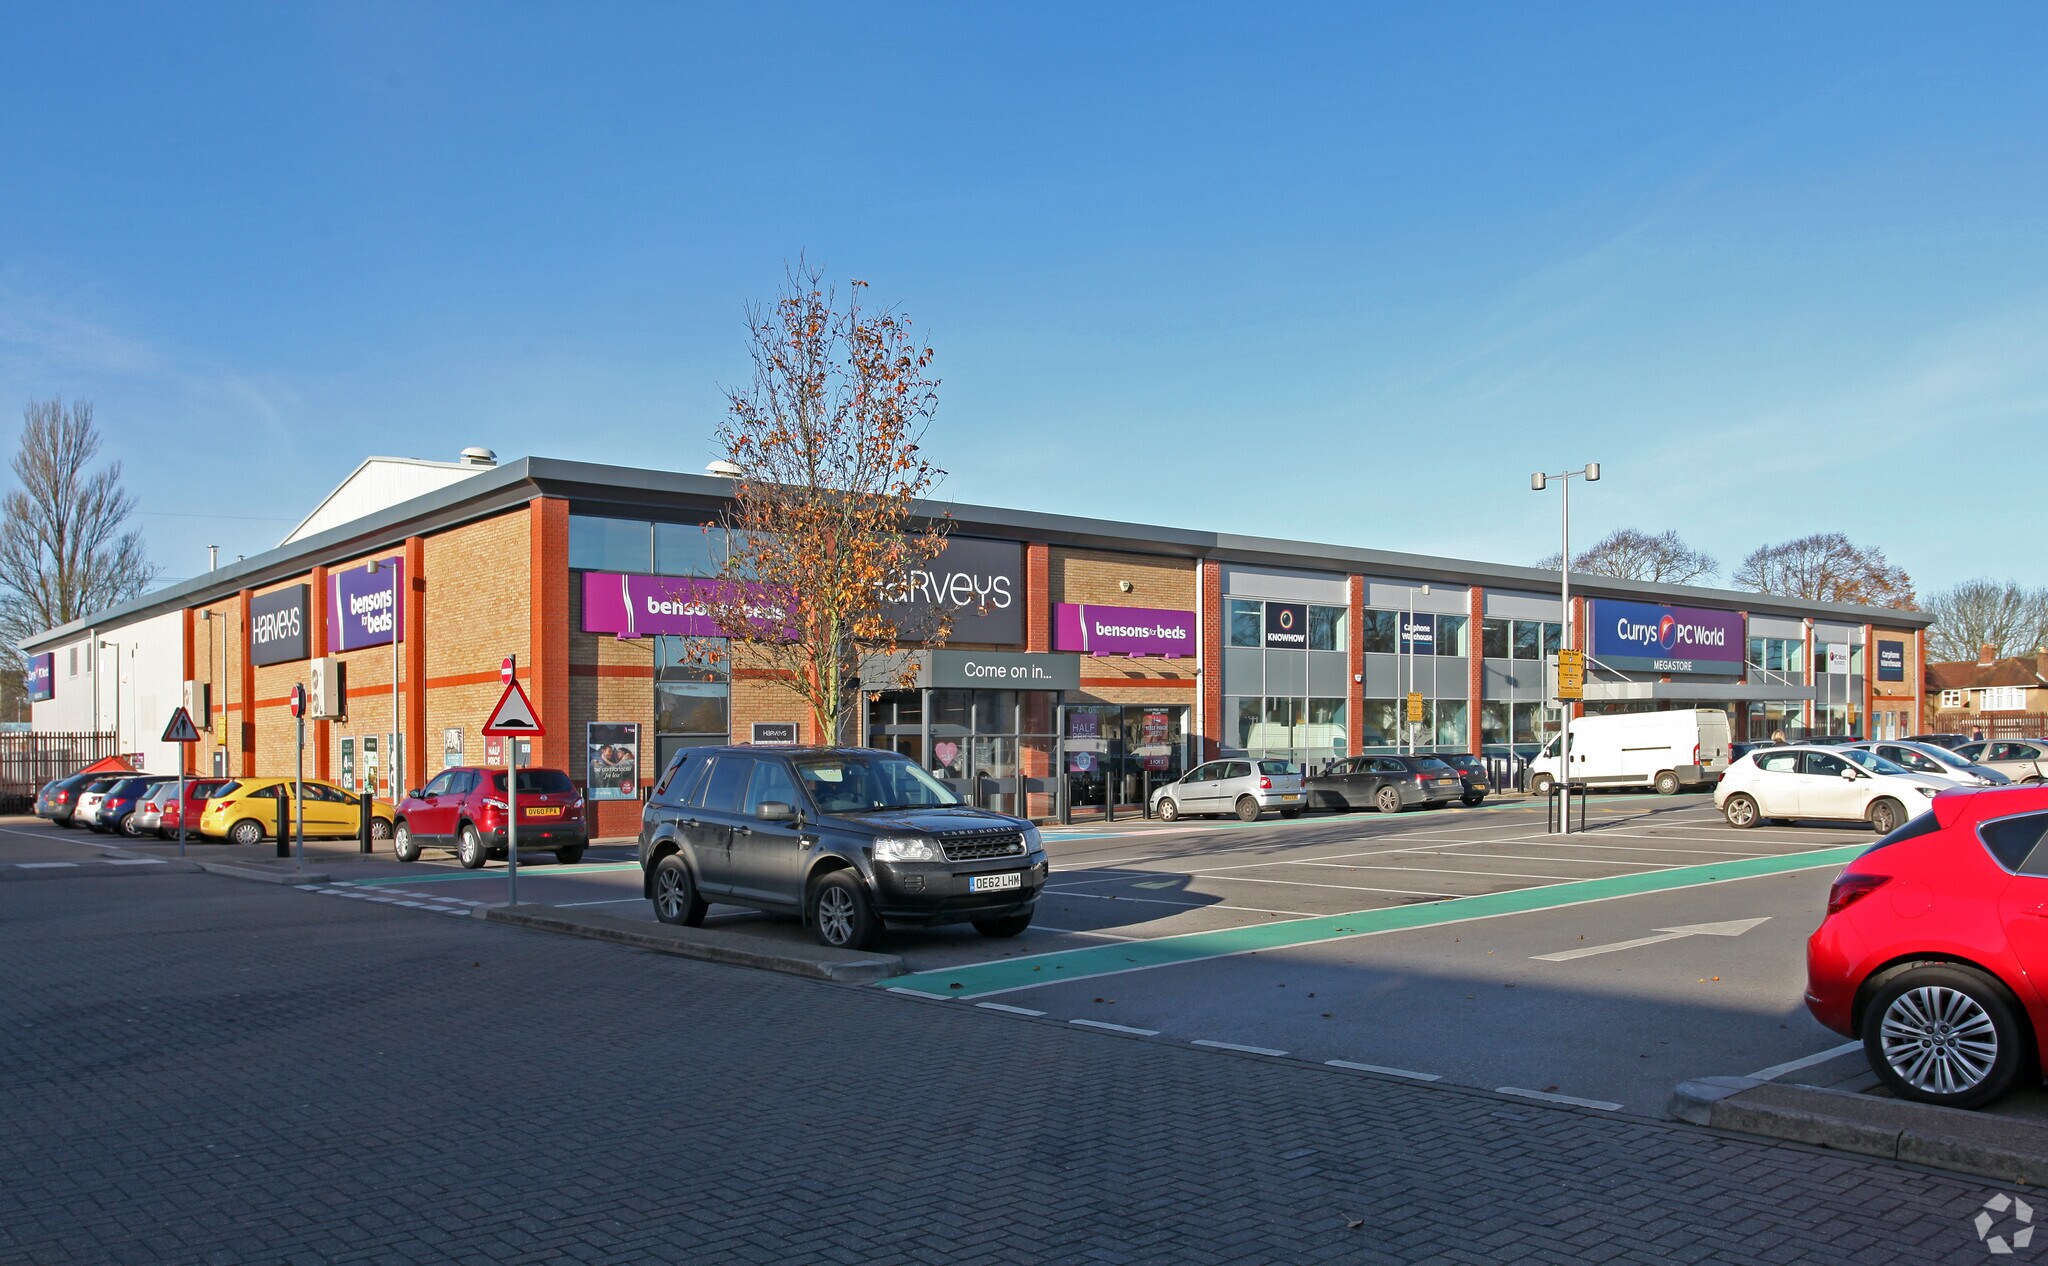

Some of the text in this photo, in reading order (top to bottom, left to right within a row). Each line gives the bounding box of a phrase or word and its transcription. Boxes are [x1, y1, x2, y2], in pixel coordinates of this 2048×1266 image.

[351, 589, 392, 616] bensons
[367, 609, 393, 635] beds
[1095, 621, 1149, 638] bensons
[1157, 624, 1187, 640] beds
[1617, 618, 1725, 646] Currys PC World
[1267, 632, 1305, 643] KNOWHOW
[964, 662, 1052, 679] Come on in...
[1653, 659, 1692, 671] MEGASTORE
[1072, 723, 1095, 733] HALF
[487, 745, 500, 756] HALF
[979, 826, 1013, 834] ROVER
[1002, 874, 1020, 887] LHM
